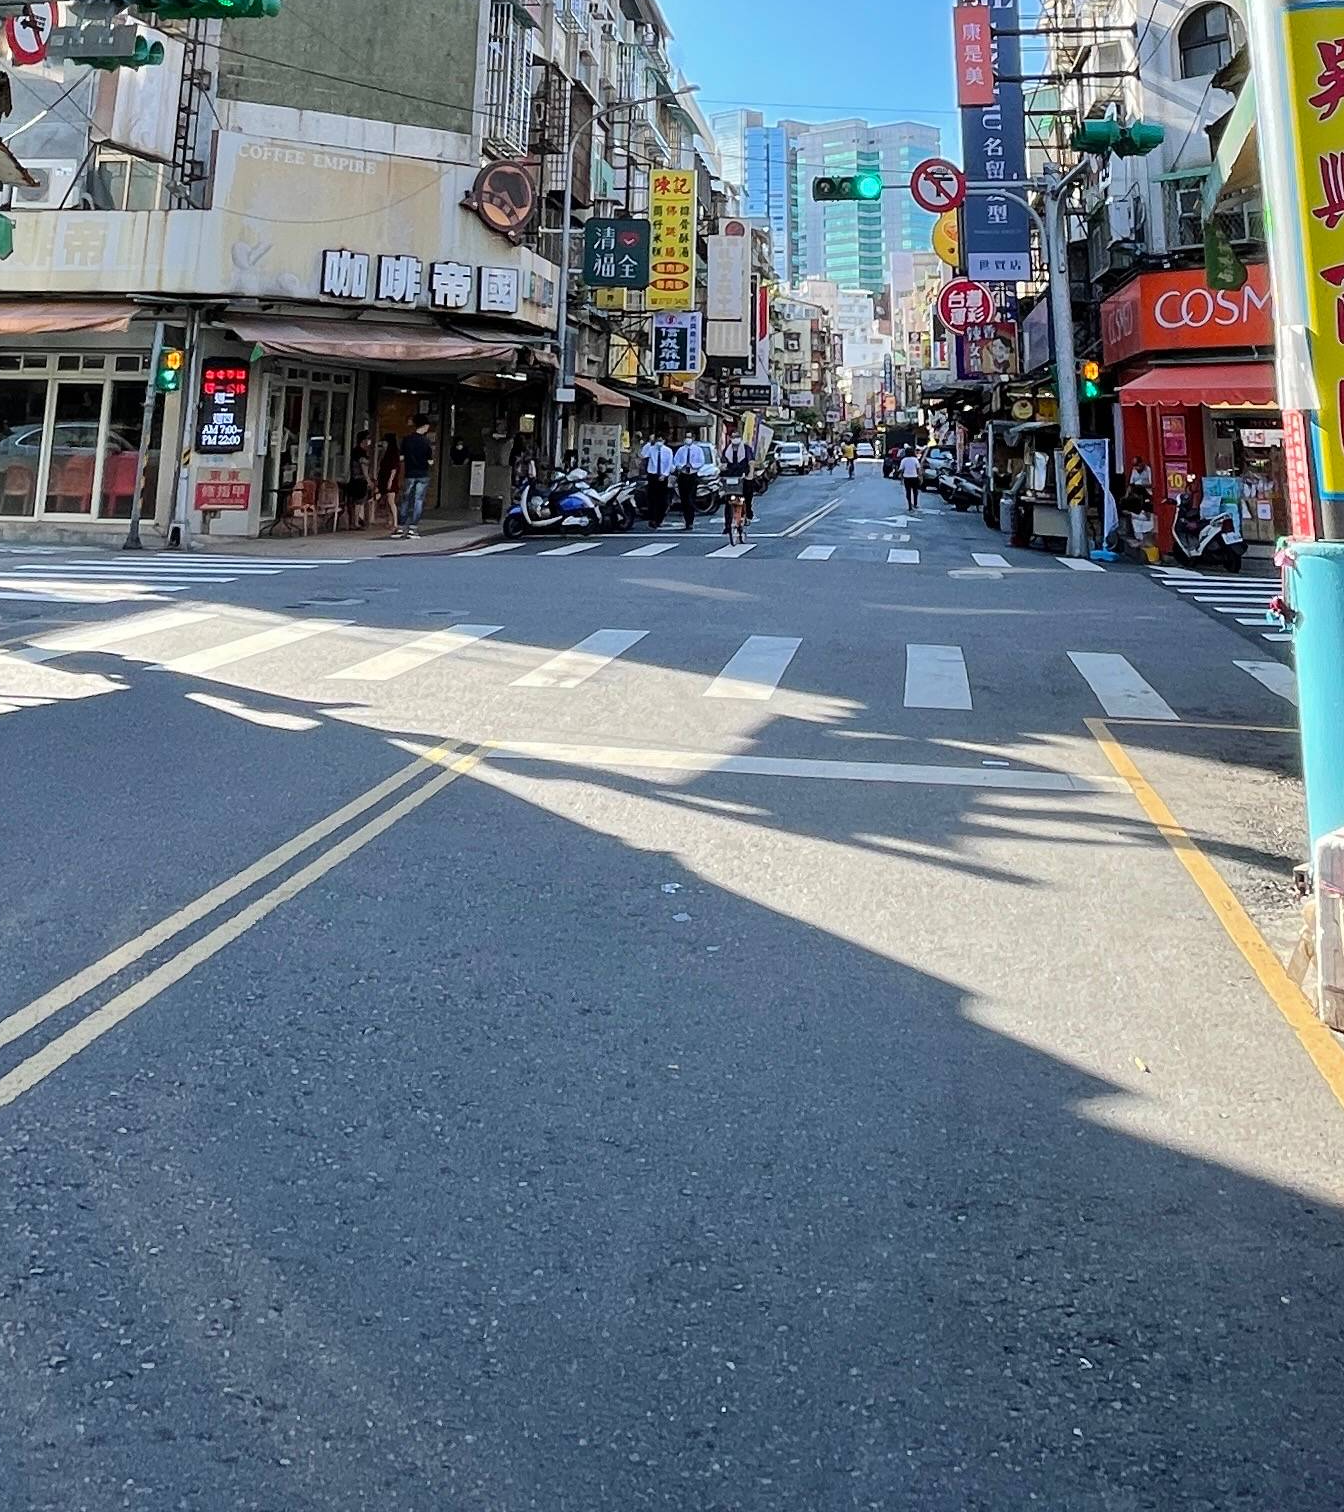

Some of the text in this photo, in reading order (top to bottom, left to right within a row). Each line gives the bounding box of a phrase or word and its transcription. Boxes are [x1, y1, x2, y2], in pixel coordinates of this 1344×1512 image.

[961, 22, 985, 87] 康是美
[238, 143, 377, 176] COFFEE EMPIRE
[653, 175, 692, 196] 陳記
[982, 137, 1008, 225] 名留型
[323, 249, 519, 314] 咖啡帝國
[201, 424, 218, 435] AM
[201, 434, 217, 446] PM
